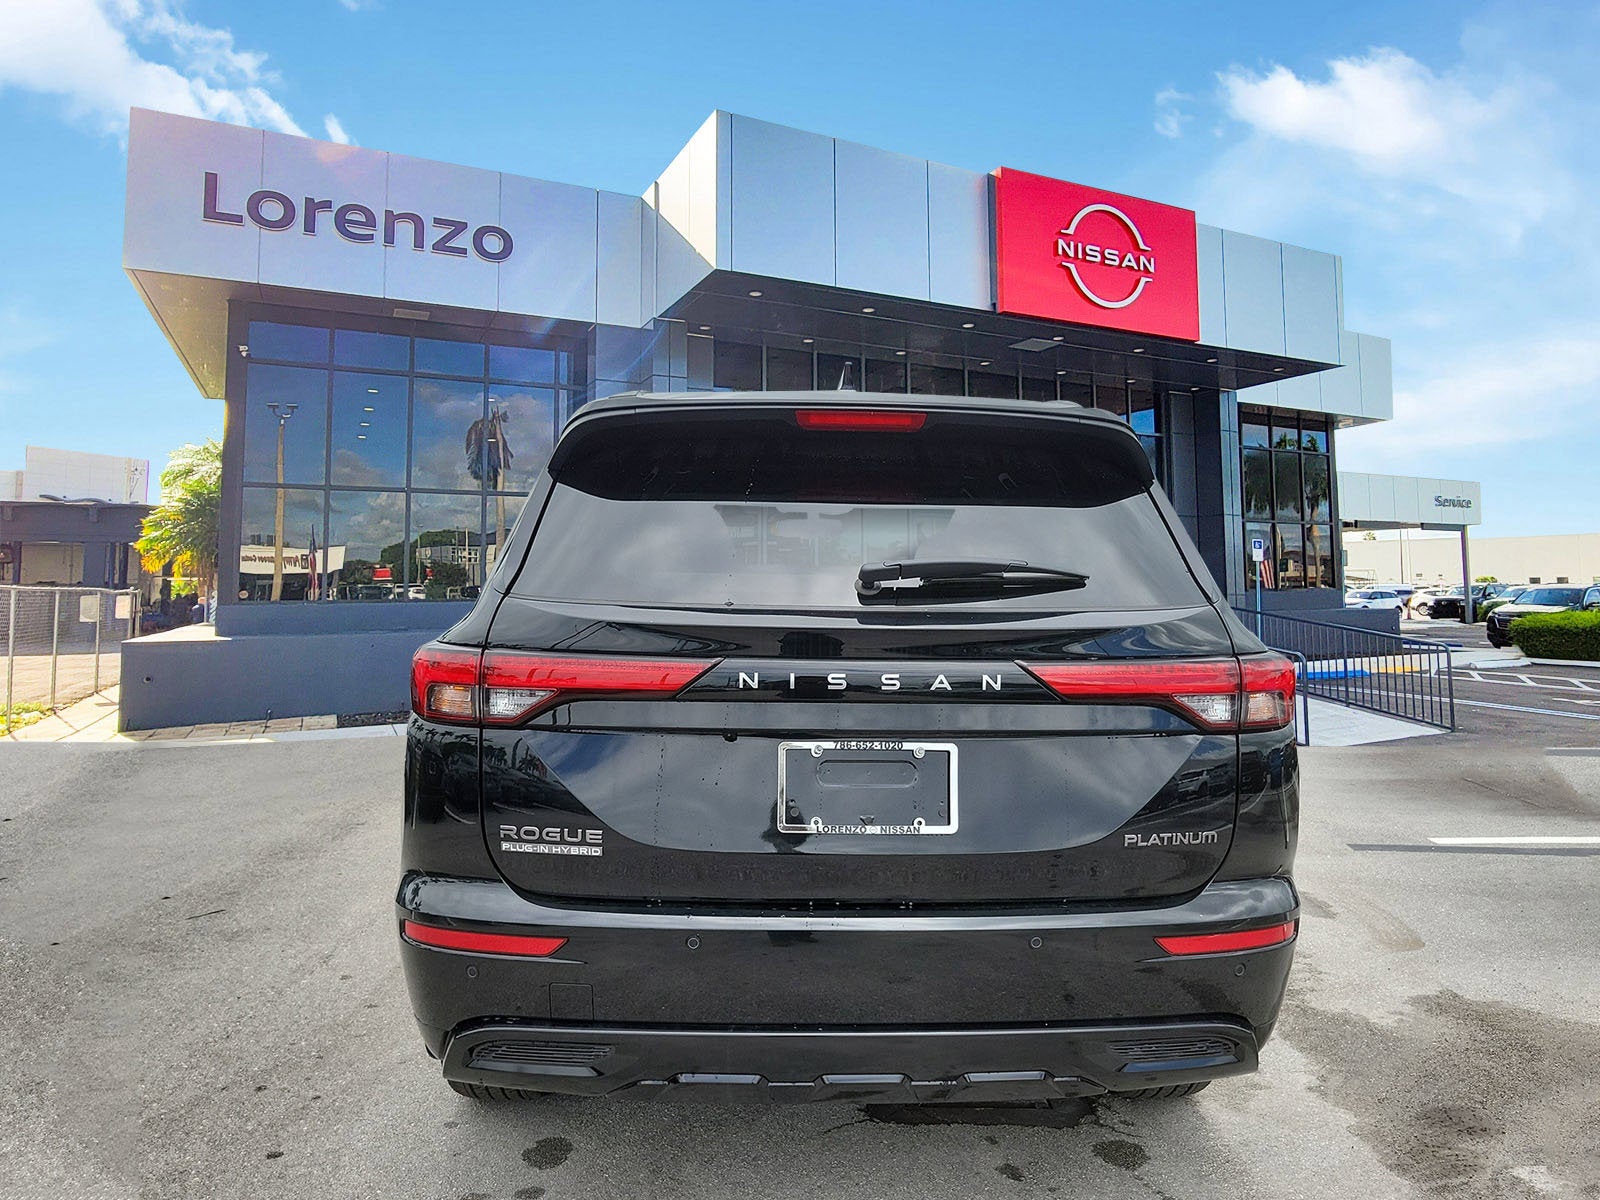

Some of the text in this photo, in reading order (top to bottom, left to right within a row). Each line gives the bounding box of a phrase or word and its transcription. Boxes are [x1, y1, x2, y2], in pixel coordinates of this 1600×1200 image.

[202, 171, 515, 262] Lorenzo
[1057, 238, 1155, 273] NISSAN
[1434, 495, 1472, 509] Service
[738, 672, 1001, 691] NISSAN
[833, 741, 903, 750] 786-652-1020
[500, 824, 603, 844] ROGUE
[816, 825, 921, 834] LORENZO NISSAN
[1124, 831, 1218, 847] PLATINUM
[502, 842, 601, 856] PLUG-IN HYBRID
